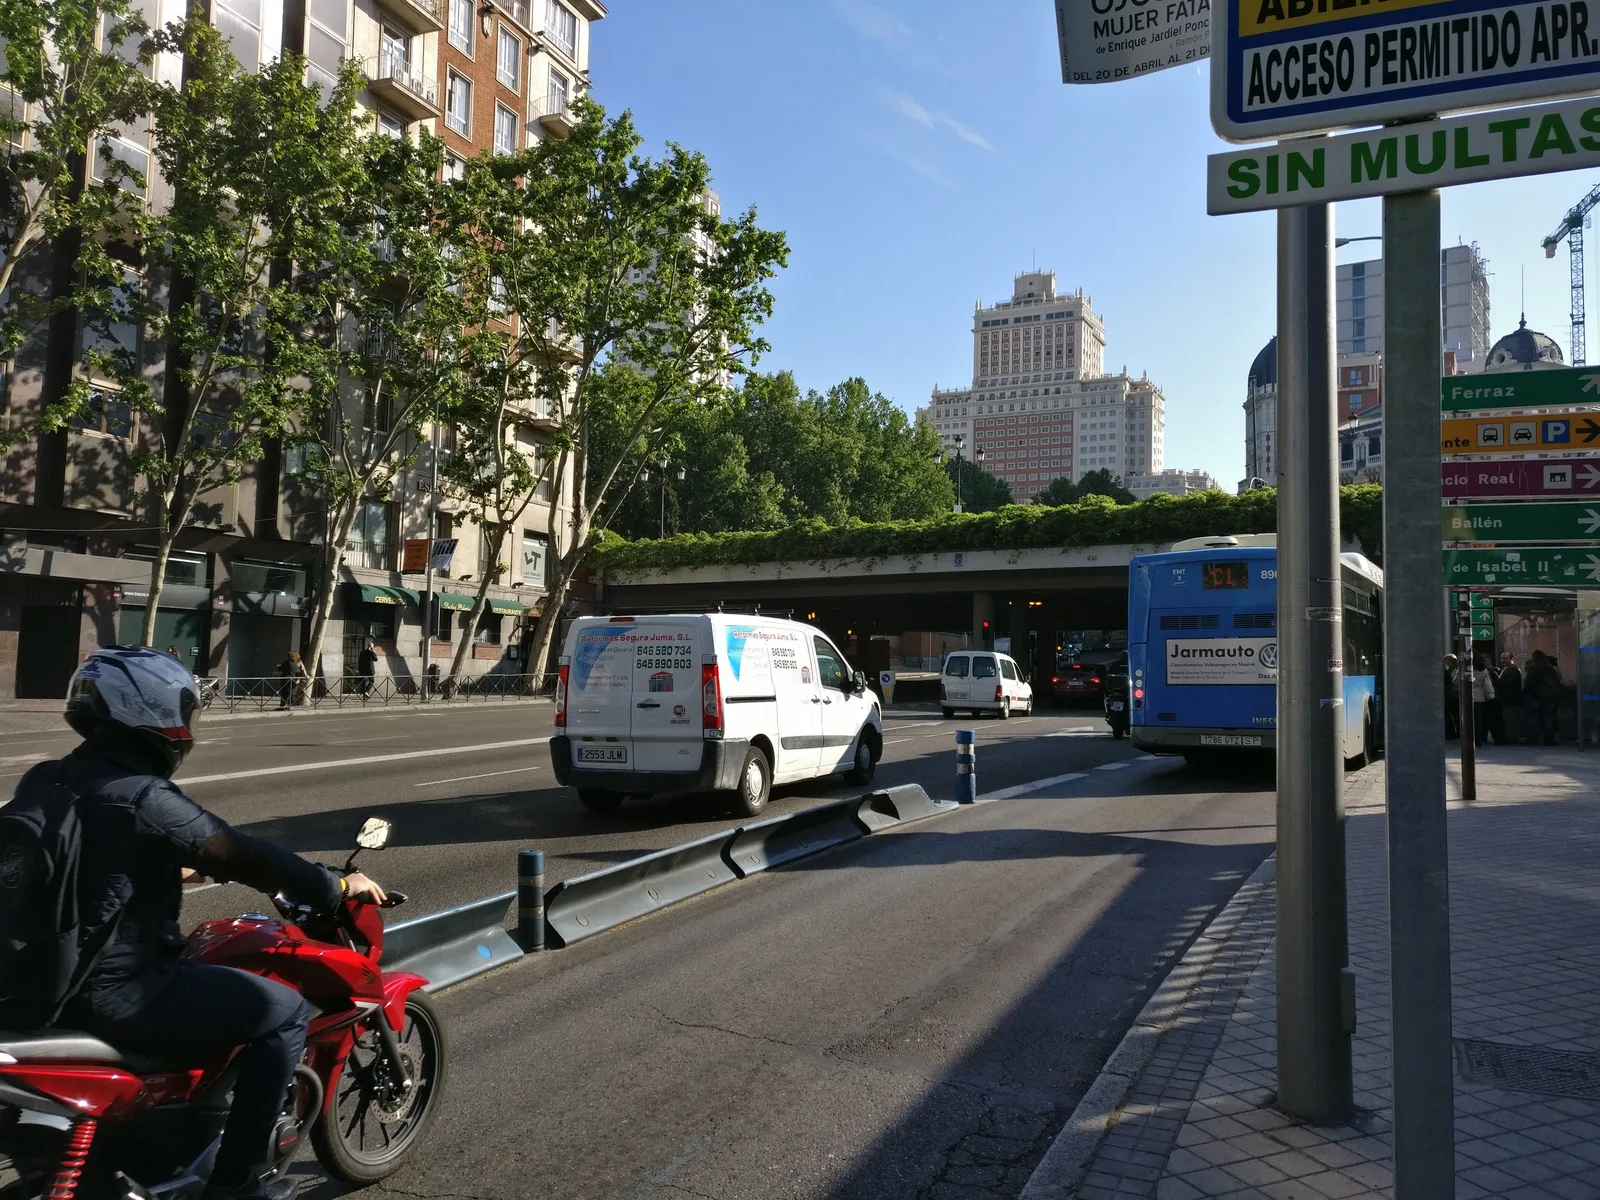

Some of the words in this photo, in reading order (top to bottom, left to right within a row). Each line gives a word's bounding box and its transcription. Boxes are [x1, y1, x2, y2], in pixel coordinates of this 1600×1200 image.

[1094, 10, 1158, 39] MUJER
[1166, 0, 1210, 22] FATA
[1096, 46, 1105, 54] de
[1108, 36, 1146, 52] Enrique
[1150, 25, 1182, 44] Jardiel
[1185, 18, 1209, 33] Ponc
[1247, 36, 1354, 106] ACCESO
[1364, 10, 1520, 88] PERMITIDO
[1530, 1, 1598, 63] APR.
[1074, 72, 1092, 81] DEL
[1096, 70, 1111, 80] 20
[1114, 66, 1130, 77] DE
[1134, 59, 1164, 74] ABRIL
[1168, 53, 1182, 65] AL
[1186, 48, 1196, 60] 21
[1226, 148, 1326, 199] SIN
[1350, 106, 1600, 184] MULTAS
[1452, 386, 1515, 400] Ferraz
[1442, 437, 1470, 448] nte
[1442, 473, 1468, 485] cio
[1479, 472, 1514, 484] Real
[1452, 516, 1502, 529] Bailén
[1453, 562, 1468, 573] de
[1477, 561, 1527, 572] Isabel
[1538, 561, 1548, 572] II
[1214, 567, 1232, 585] C1
[620, 634, 648, 642] Segura
[650, 634, 675, 642] Juma,
[637, 646, 654, 656] 646
[656, 646, 672, 655] 580
[675, 646, 691, 655] 734
[1170, 644, 1255, 658] Jarmauto
[636, 660, 653, 668] 645
[655, 660, 672, 668] 890
[674, 659, 691, 668] 803
[585, 748, 605, 760] 2553
[607, 749, 622, 760] JLM
